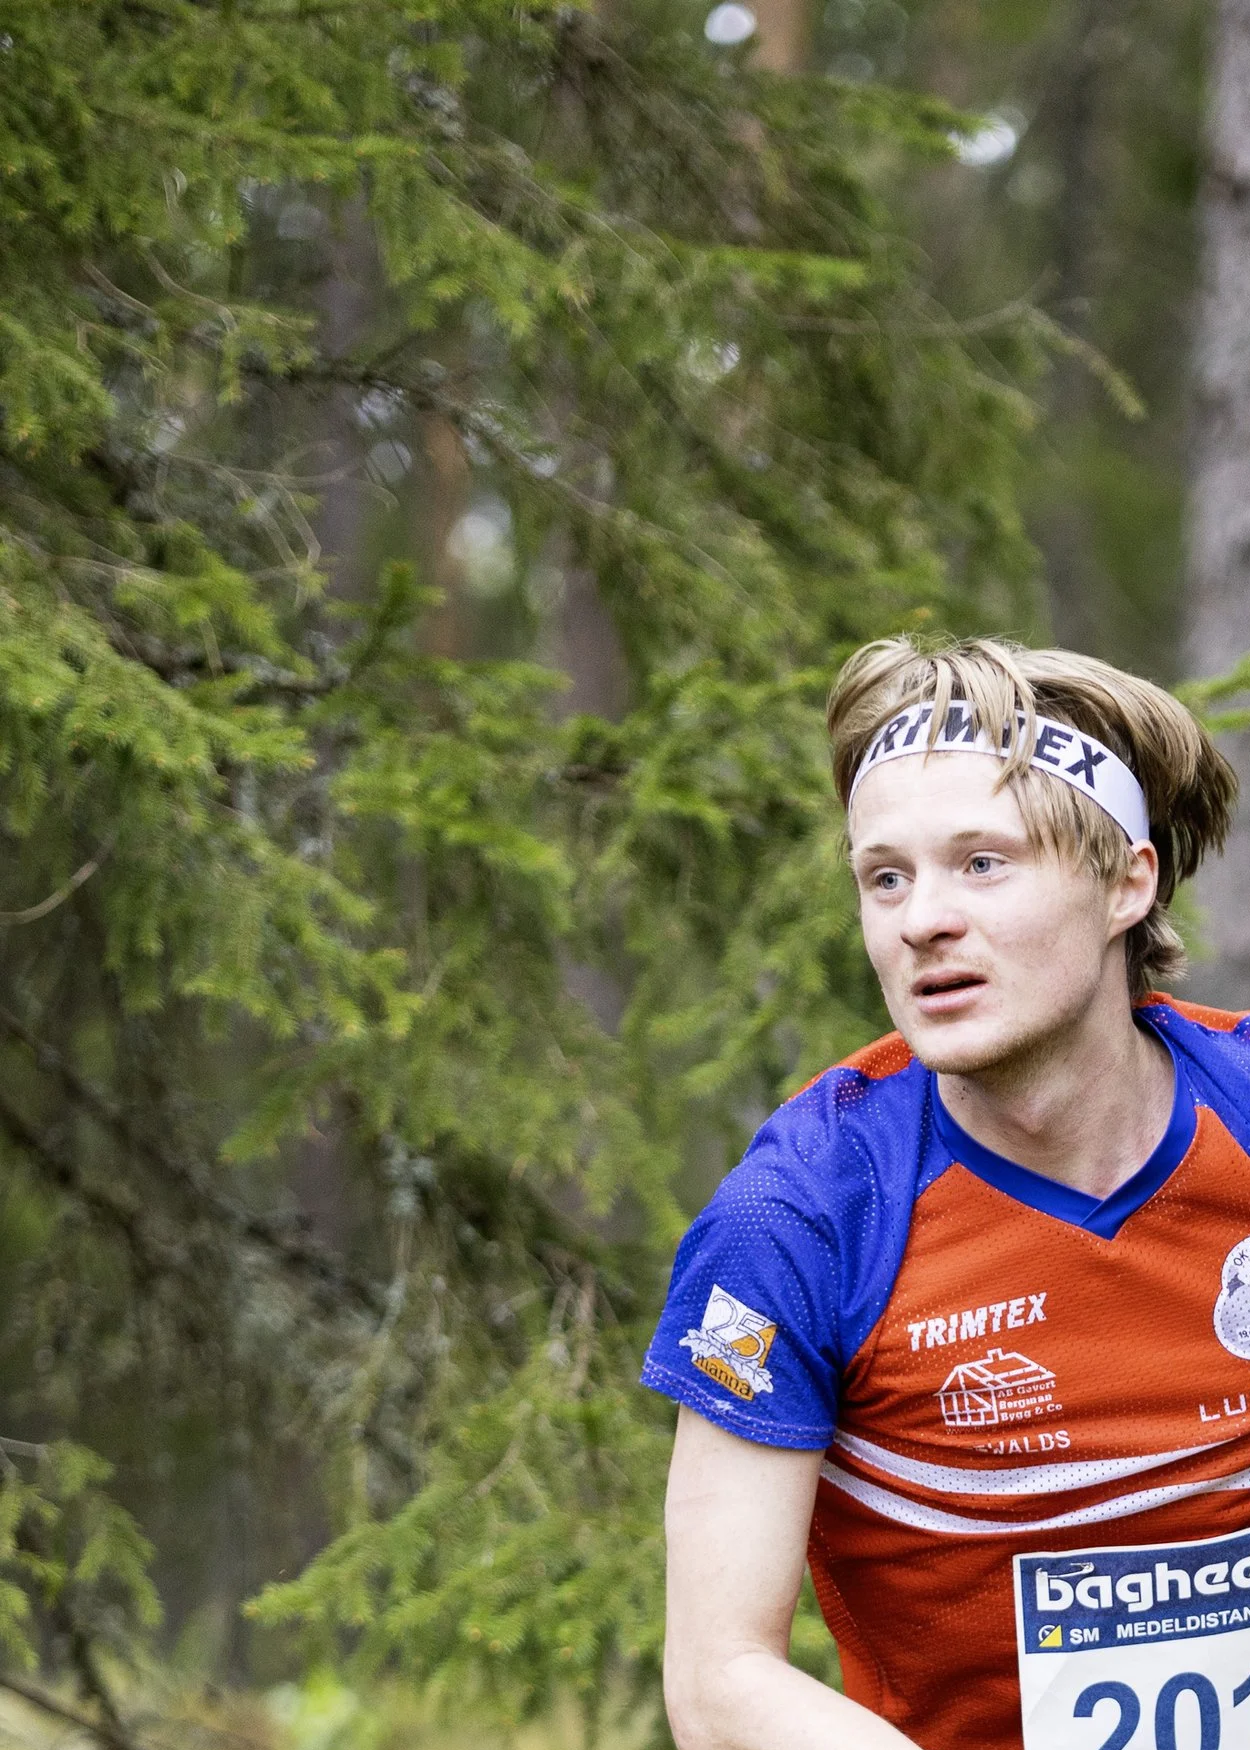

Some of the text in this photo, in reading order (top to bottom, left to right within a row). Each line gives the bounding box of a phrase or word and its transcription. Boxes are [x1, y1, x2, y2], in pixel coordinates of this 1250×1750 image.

[868, 706, 1108, 790] RIMEX
[1233, 1249, 1249, 1267] OK
[705, 1293, 767, 1361] 25
[907, 1291, 1048, 1352] TRIMTEX
[998, 1393, 1054, 1411] Bergman
[1000, 1409, 1032, 1423] Bygg
[1046, 1402, 1063, 1413] Co
[1068, 1626, 1100, 1646] SM
